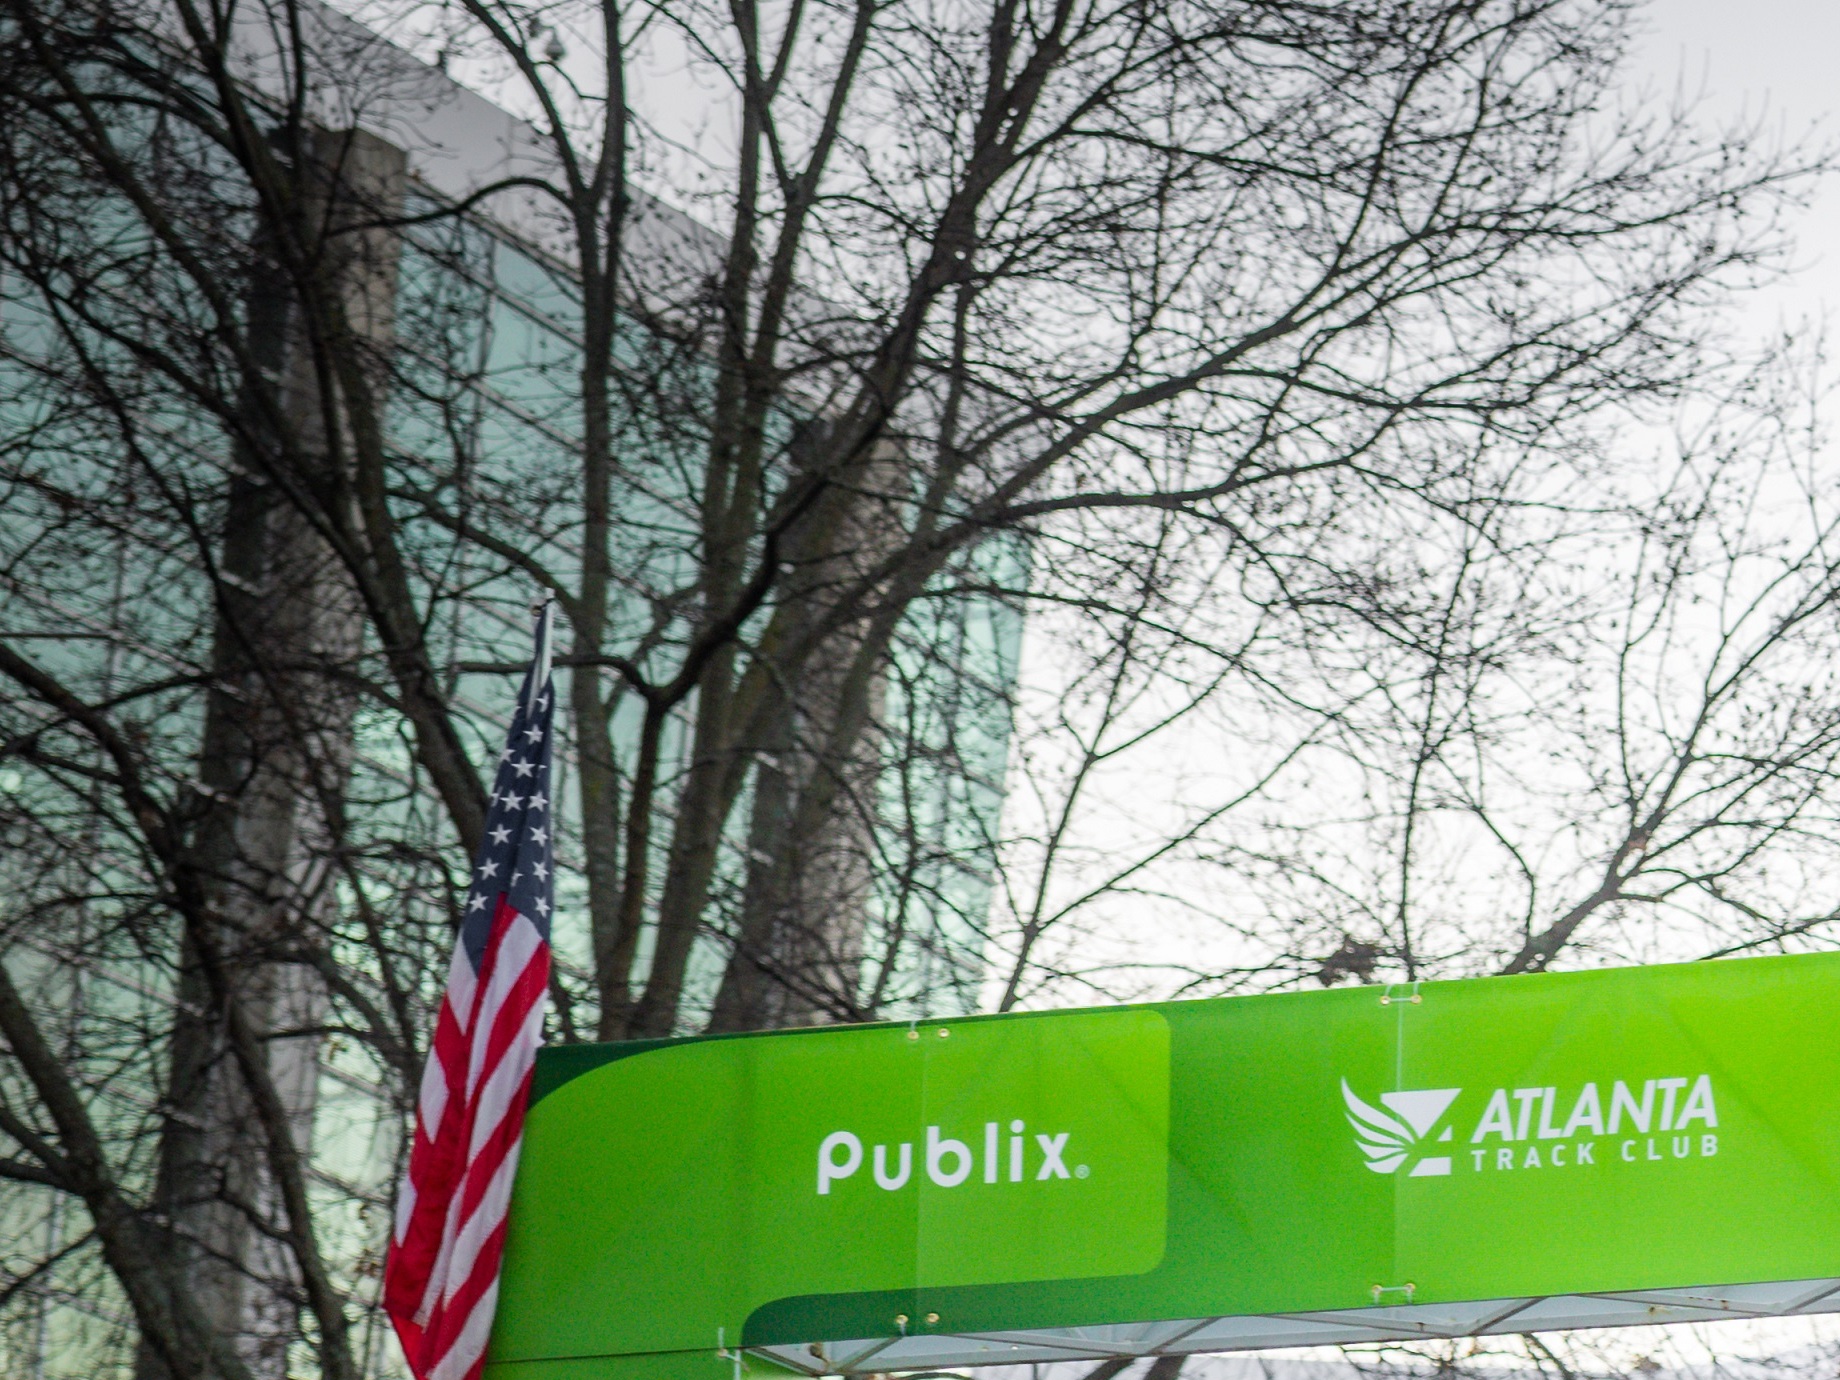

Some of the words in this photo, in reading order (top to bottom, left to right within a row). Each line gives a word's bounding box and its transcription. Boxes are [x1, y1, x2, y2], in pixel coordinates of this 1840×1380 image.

[1471, 1073, 1719, 1144] ATLANTA
[816, 1119, 1072, 1195] Publix
[1471, 1142, 1596, 1172] TRACK
[1621, 1133, 1720, 1163] CLUB
